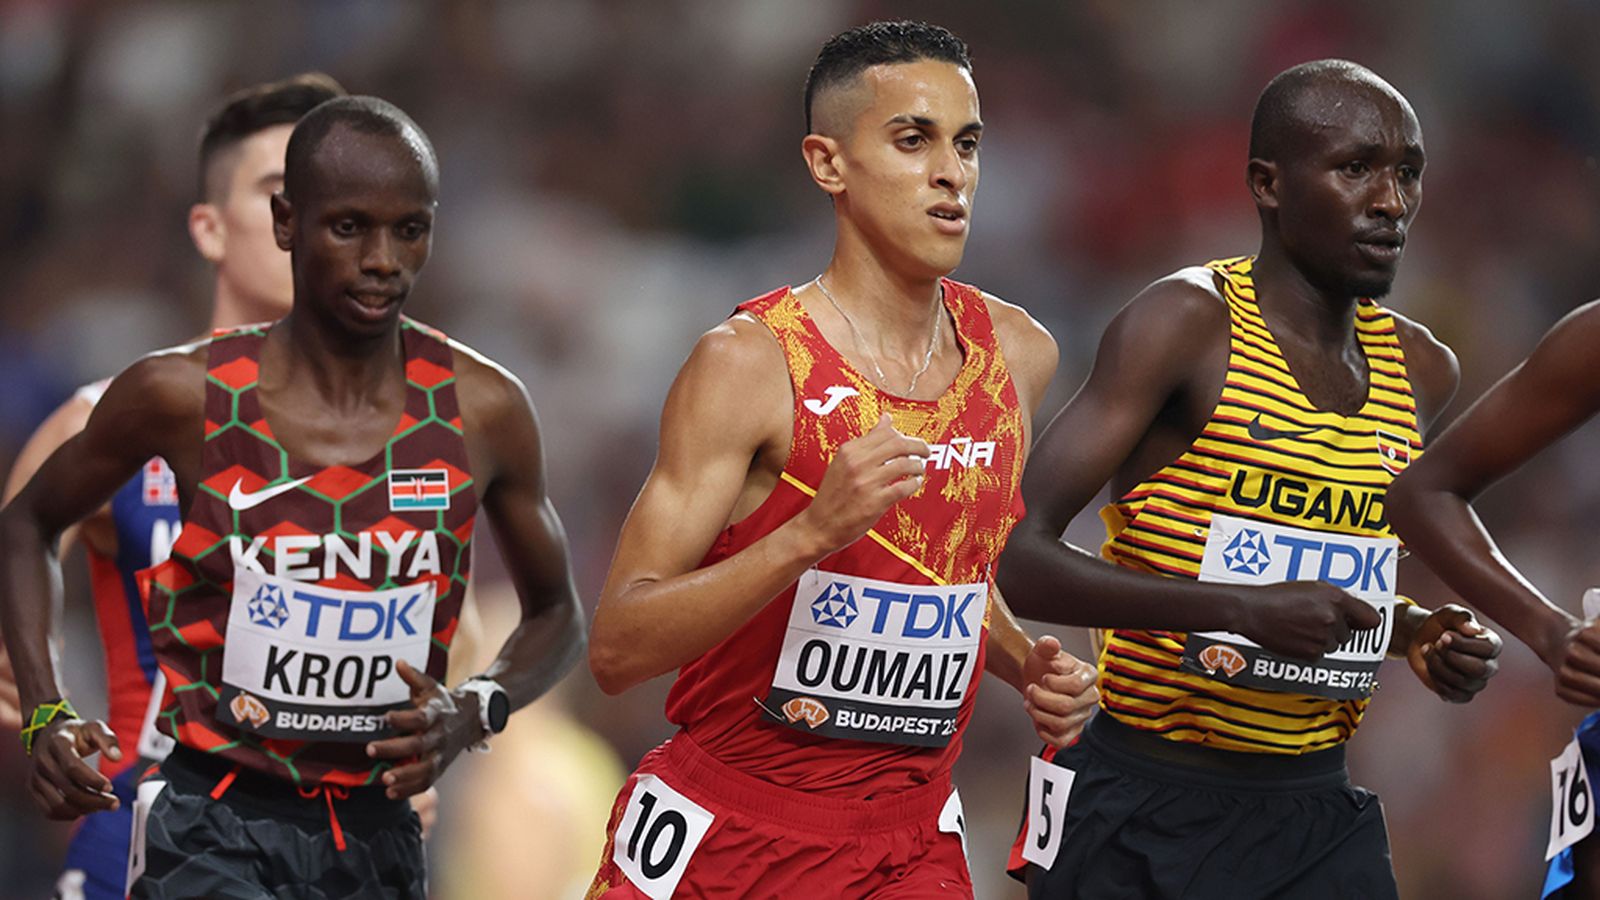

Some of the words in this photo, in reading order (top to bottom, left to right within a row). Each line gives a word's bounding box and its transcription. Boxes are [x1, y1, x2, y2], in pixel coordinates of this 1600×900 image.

[921, 437, 996, 470] AÑA
[1230, 469, 1389, 532] UGAND
[230, 530, 441, 580] KENYA
[1274, 534, 1393, 592] TDK
[293, 590, 421, 640] TDK
[862, 587, 977, 639] TDK
[263, 645, 392, 699] KROP
[796, 639, 969, 700] OUMAIZ
[1037, 779, 1054, 850] 5
[1557, 754, 1589, 837] 16
[627, 790, 687, 880] 10
